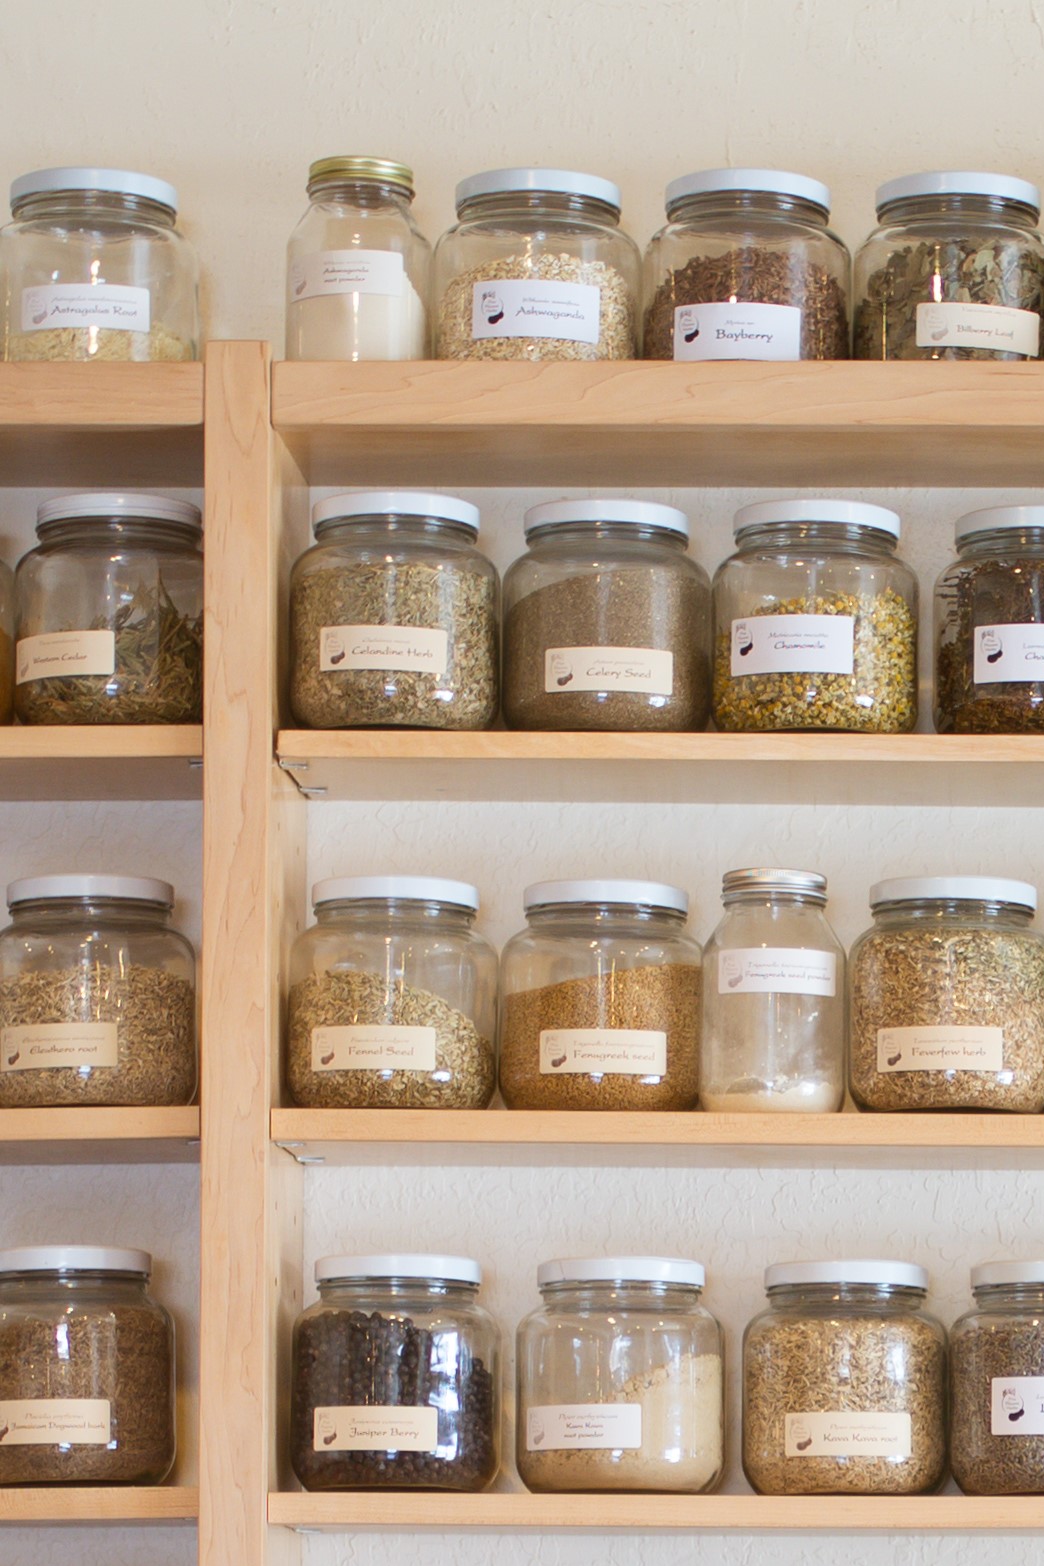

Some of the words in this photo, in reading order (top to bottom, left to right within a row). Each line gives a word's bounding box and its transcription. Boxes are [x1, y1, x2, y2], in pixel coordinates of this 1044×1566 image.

[51, 304, 110, 317] Astragalus
[113, 305, 138, 317] Root
[514, 306, 584, 320] Ashwaganda
[715, 328, 774, 343] Bayberry
[352, 646, 404, 656] Celandine
[586, 667, 622, 679] Celery
[624, 668, 652, 679] Seed
[348, 1045, 383, 1056] Fennel
[385, 1045, 415, 1056] Seed
[349, 1427, 388, 1439] Juniper
[390, 1427, 419, 1439] Berry
[823, 1433, 849, 1442] Kava
[852, 1433, 879, 1442] Kava
